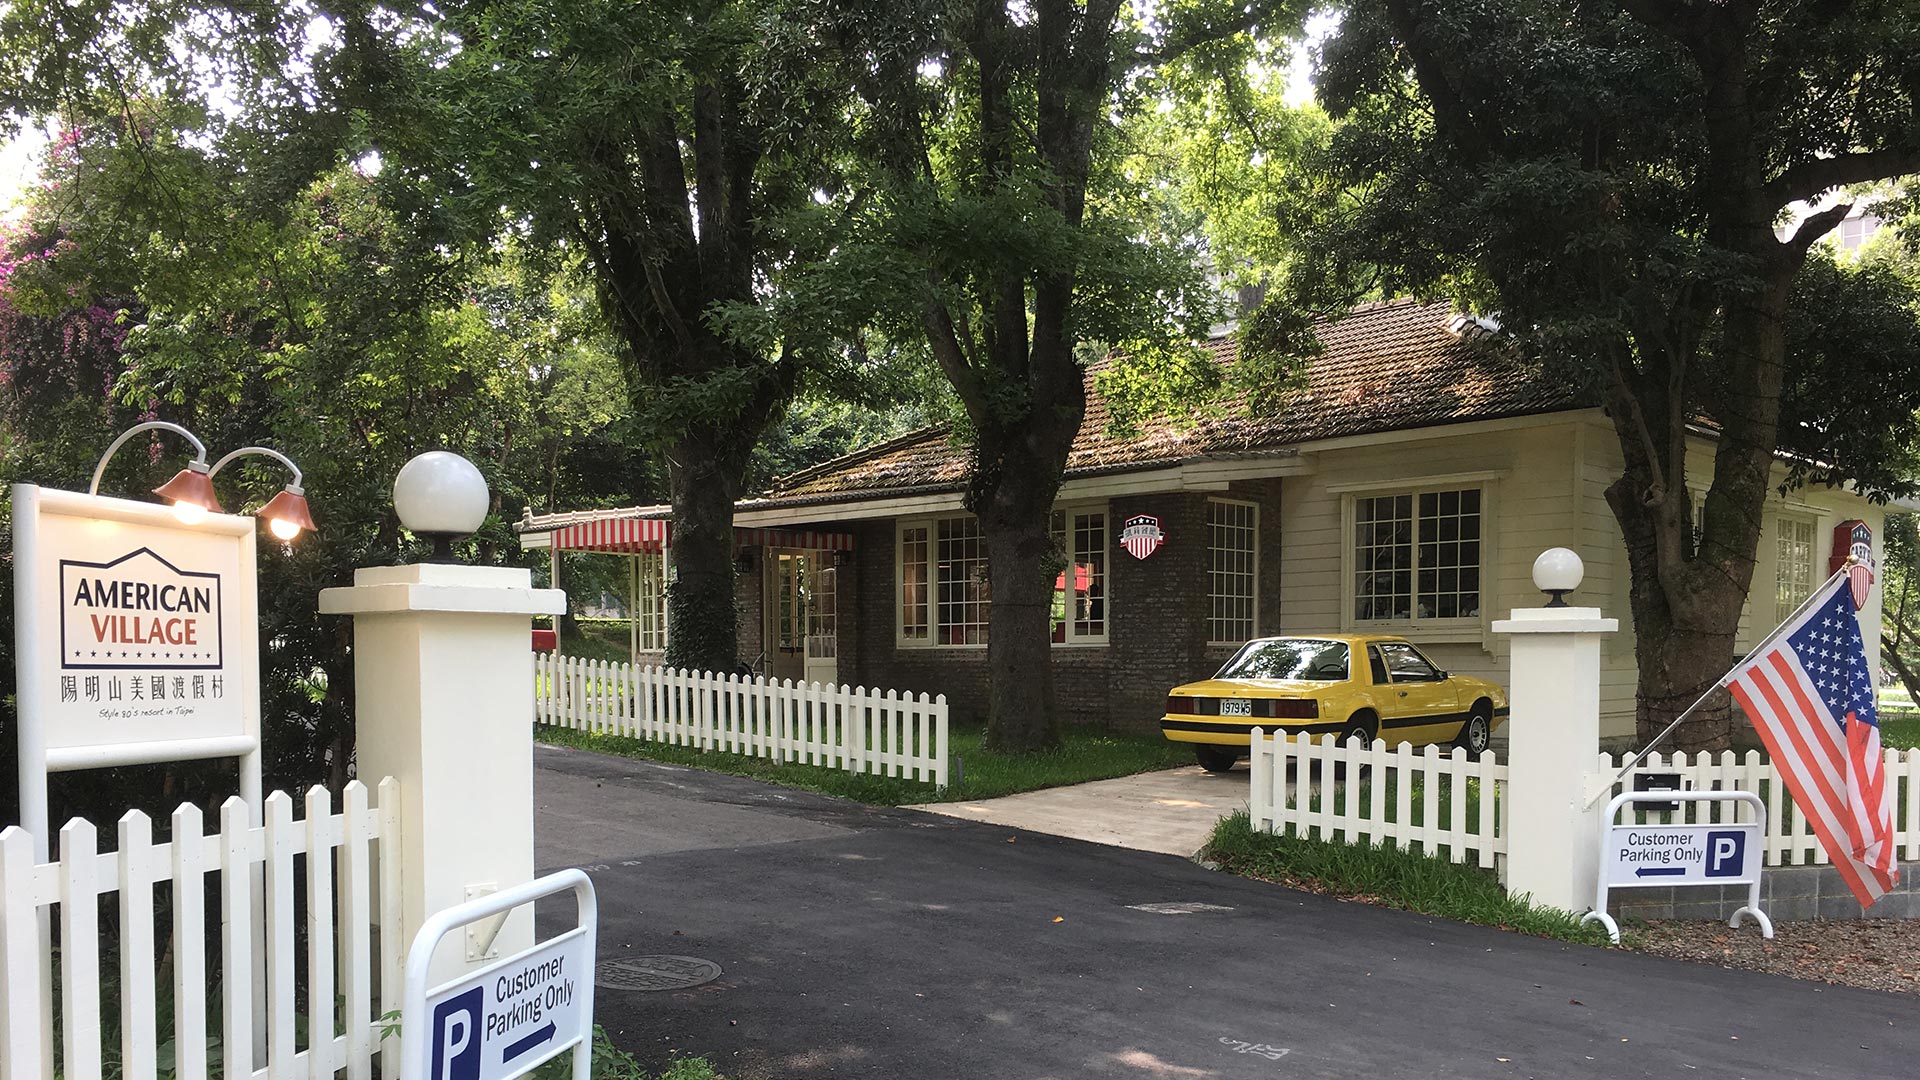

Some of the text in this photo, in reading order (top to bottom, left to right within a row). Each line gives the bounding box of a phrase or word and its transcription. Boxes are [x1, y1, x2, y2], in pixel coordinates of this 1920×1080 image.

[73, 578, 211, 614] AMERICAN
[90, 614, 198, 646] VILLAGE
[61, 674, 224, 703] 陽明山美國渡假村
[98, 708, 119, 720] Style
[141, 708, 164, 717] resort
[165, 707, 173, 716] in
[174, 705, 196, 717] Taipei
[1619, 847, 1703, 863] Parking Only
[1628, 832, 1694, 846] Customer
[1713, 837, 1737, 871] P
[496, 955, 565, 1003] Customer
[486, 978, 575, 1042] Parking Only
[442, 1008, 472, 1080] P
